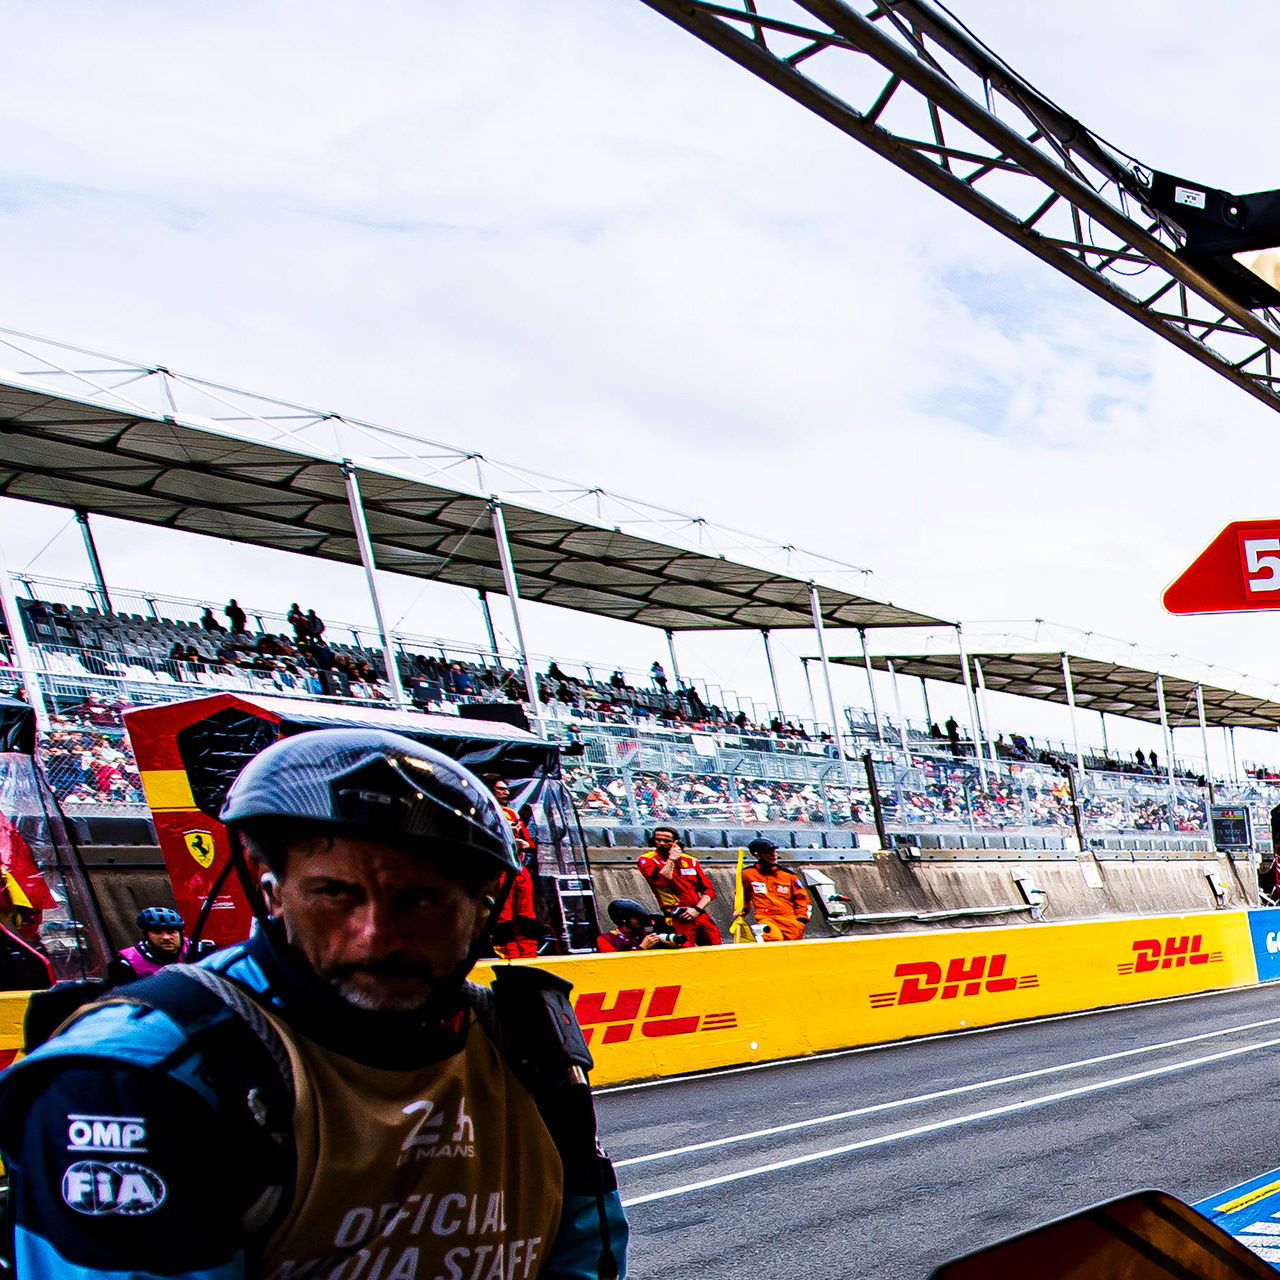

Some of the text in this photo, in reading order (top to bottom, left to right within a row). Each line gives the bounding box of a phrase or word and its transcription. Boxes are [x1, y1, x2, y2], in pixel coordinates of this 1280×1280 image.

[896, 953, 1019, 1006] DHL
[1132, 934, 1211, 974] DHL
[575, 984, 700, 1046] HL
[68, 1120, 146, 1148] OMP
[333, 1190, 508, 1248] OFFICIAL
